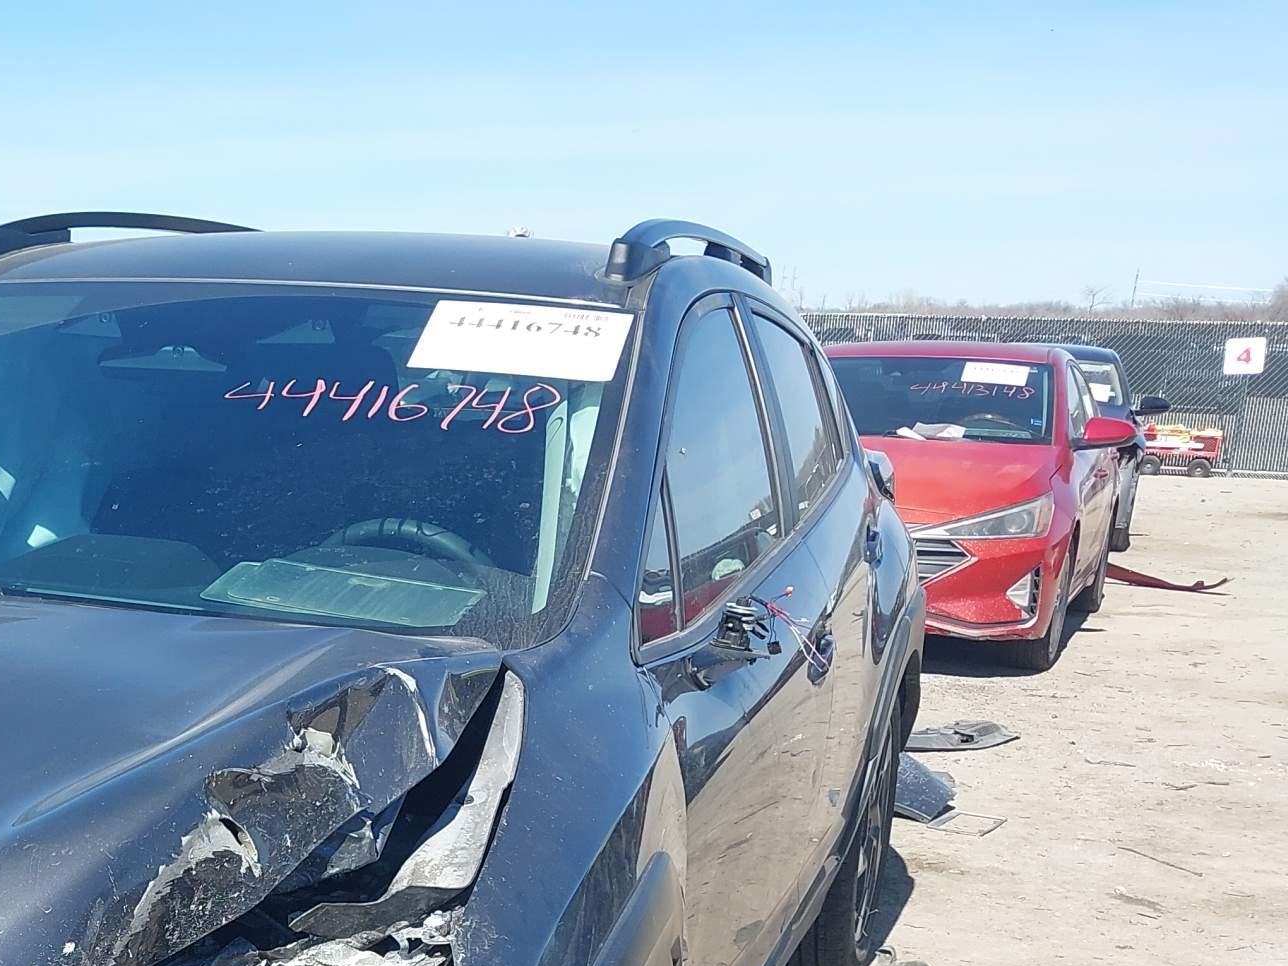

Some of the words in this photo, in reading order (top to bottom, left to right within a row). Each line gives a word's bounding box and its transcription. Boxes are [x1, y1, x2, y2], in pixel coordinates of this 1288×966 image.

[449, 317, 602, 337] 44416748
[1237, 348, 1251, 364] 4
[910, 381, 1035, 399] 44413148
[224, 379, 561, 433] 44416748
